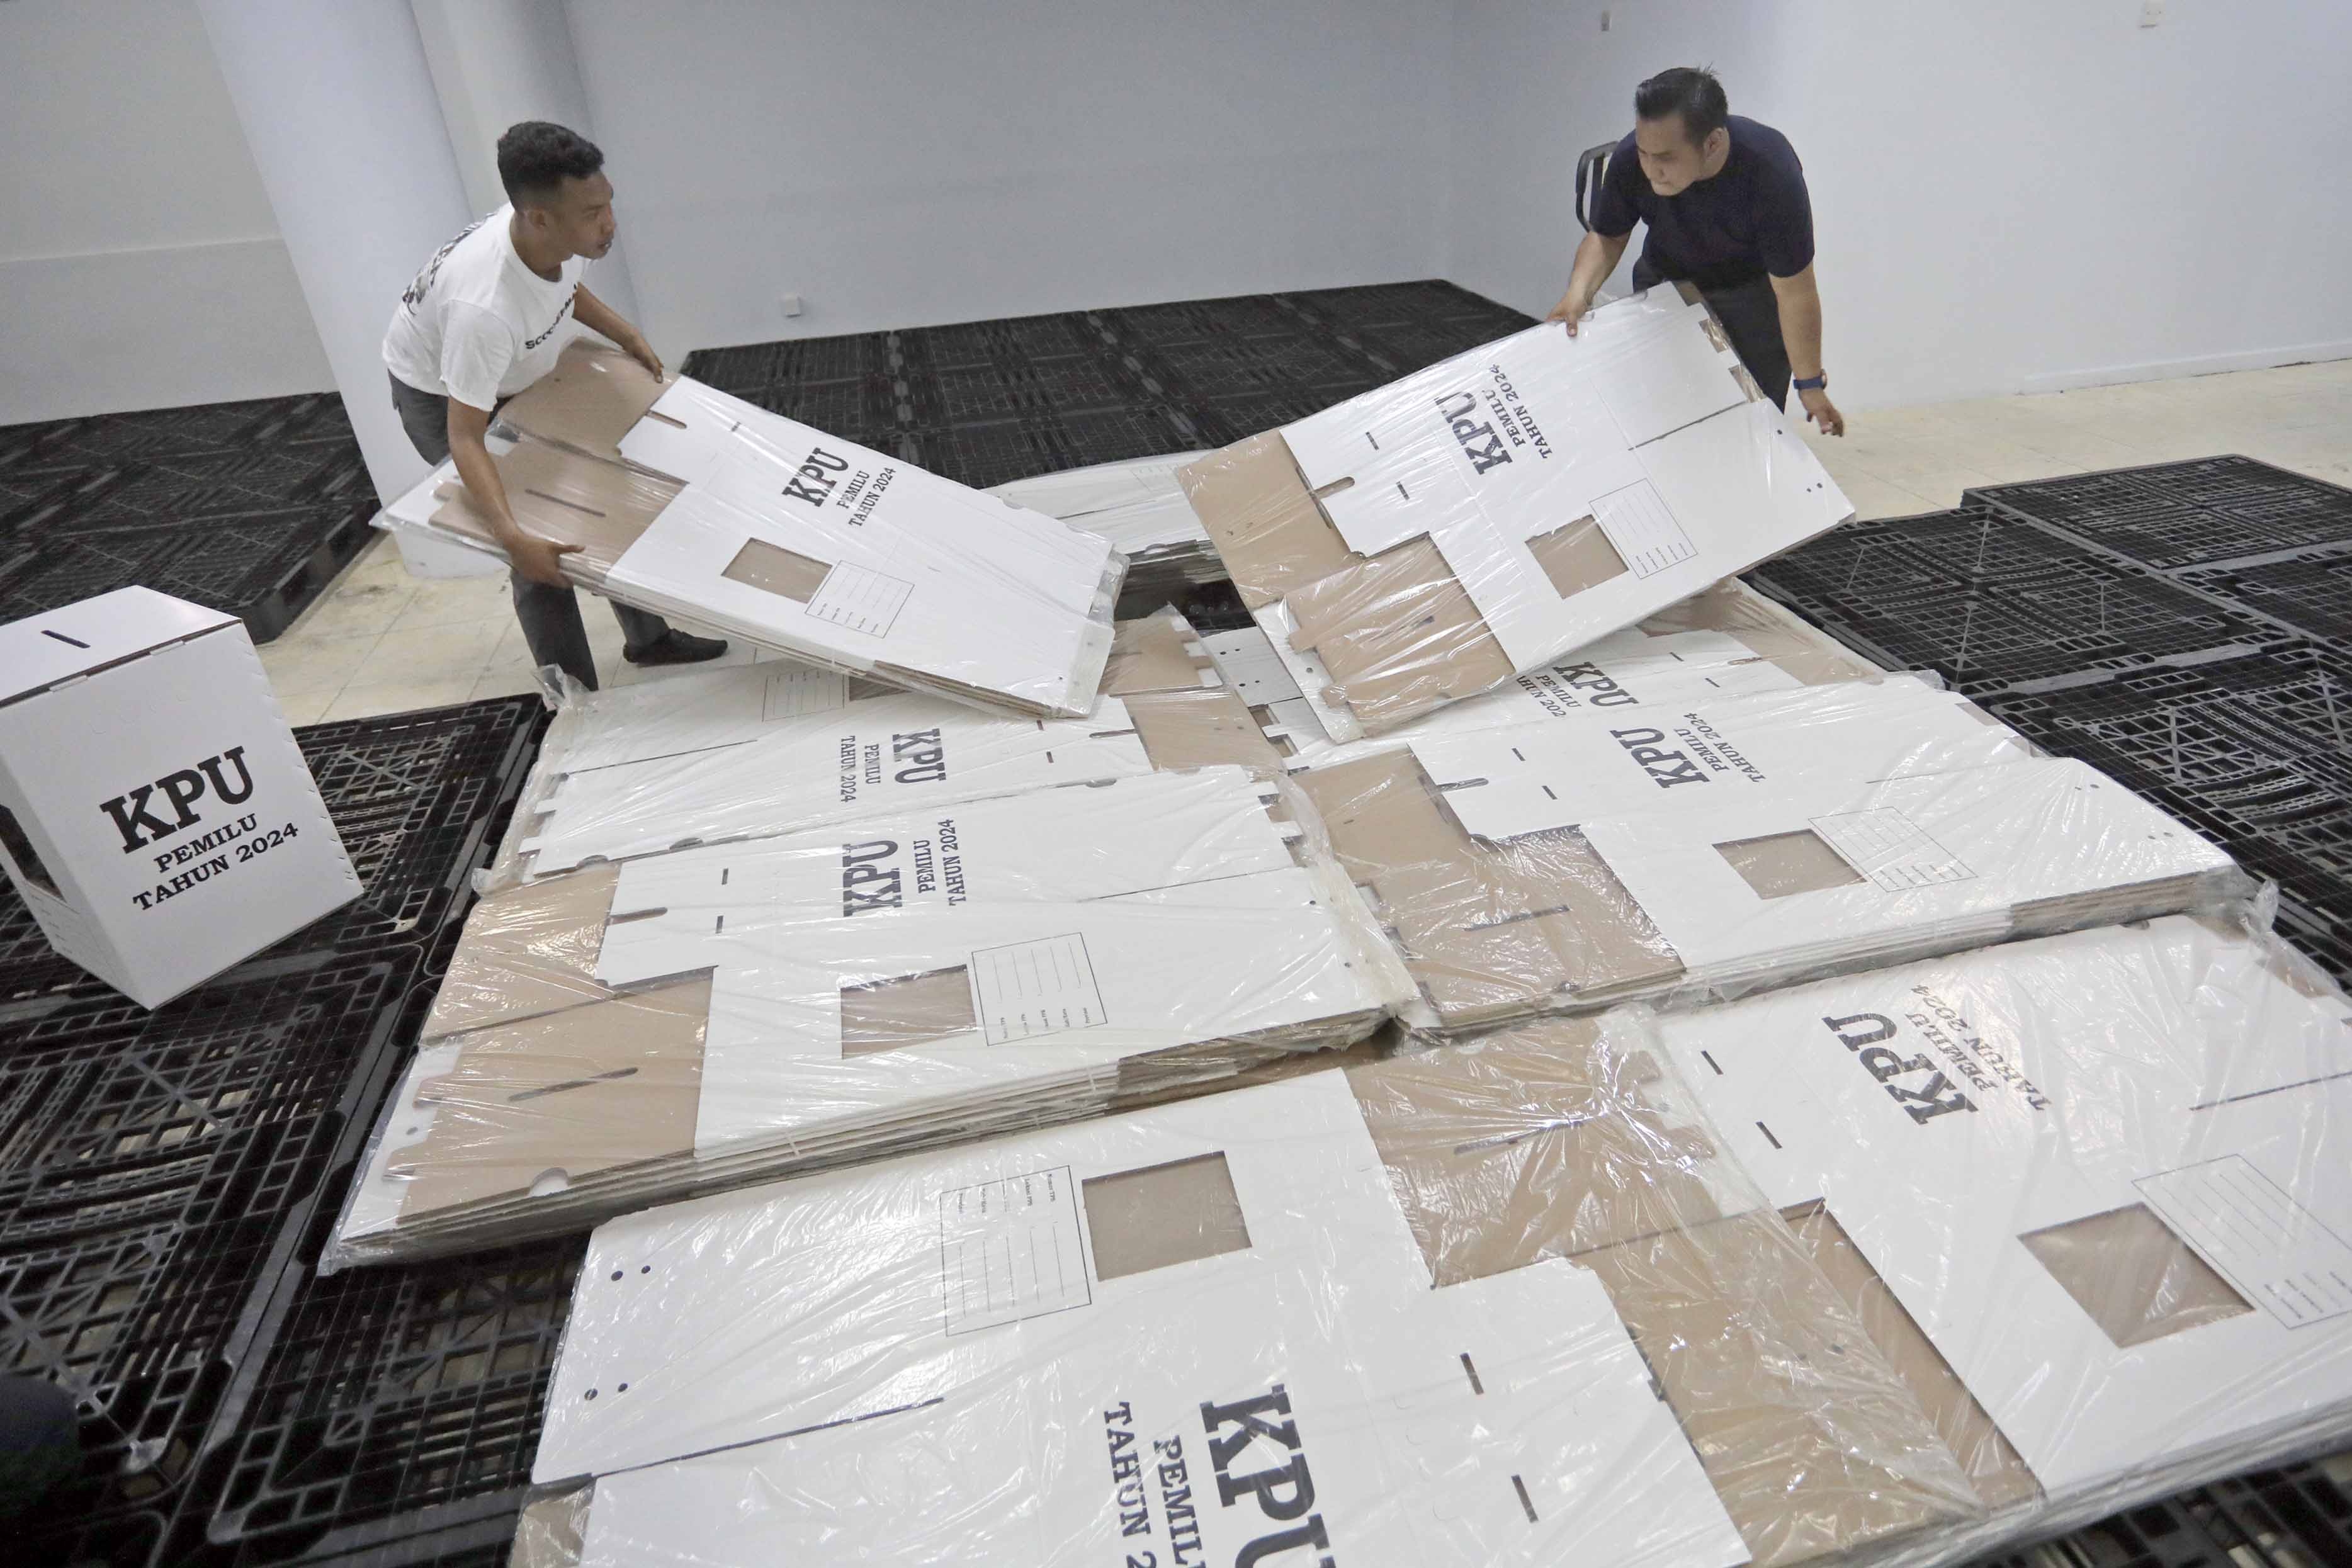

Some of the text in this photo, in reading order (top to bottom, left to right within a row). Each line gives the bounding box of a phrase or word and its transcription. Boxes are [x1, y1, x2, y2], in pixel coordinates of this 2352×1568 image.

[1434, 392, 1513, 475] KPU
[1481, 389, 1526, 447] PEMILU
[1489, 364, 1552, 458] TAHUN 2024
[781, 447, 849, 507] KPU
[837, 471, 870, 509] PEMILU
[849, 466, 896, 526] TAHUN 2024
[1535, 675, 1581, 708] PEMILU
[1540, 699, 1566, 716] 202
[1552, 662, 1639, 706] KPU
[840, 735, 856, 802] TAHUN 2024
[893, 728, 946, 784] KPU
[1609, 728, 1710, 789] KPU
[1673, 728, 1730, 772] PEMILU
[1683, 712, 1767, 782] TAHUN 2024
[99, 746, 254, 854] KPU
[133, 823, 298, 911] TAHUN 2024
[154, 813, 257, 873] PEMILU
[913, 839, 936, 894] PEMILU
[937, 820, 966, 906] TAHUN 2024
[842, 840, 902, 917] KPU
[1821, 1013, 1979, 1125] KPU
[1904, 1013, 1999, 1091] PEMILU
[1910, 984, 2051, 1110] TAHUN 2024
[1104, 1401, 1151, 1537] TAHUN
[1153, 1435, 1207, 1568] PEMIL
